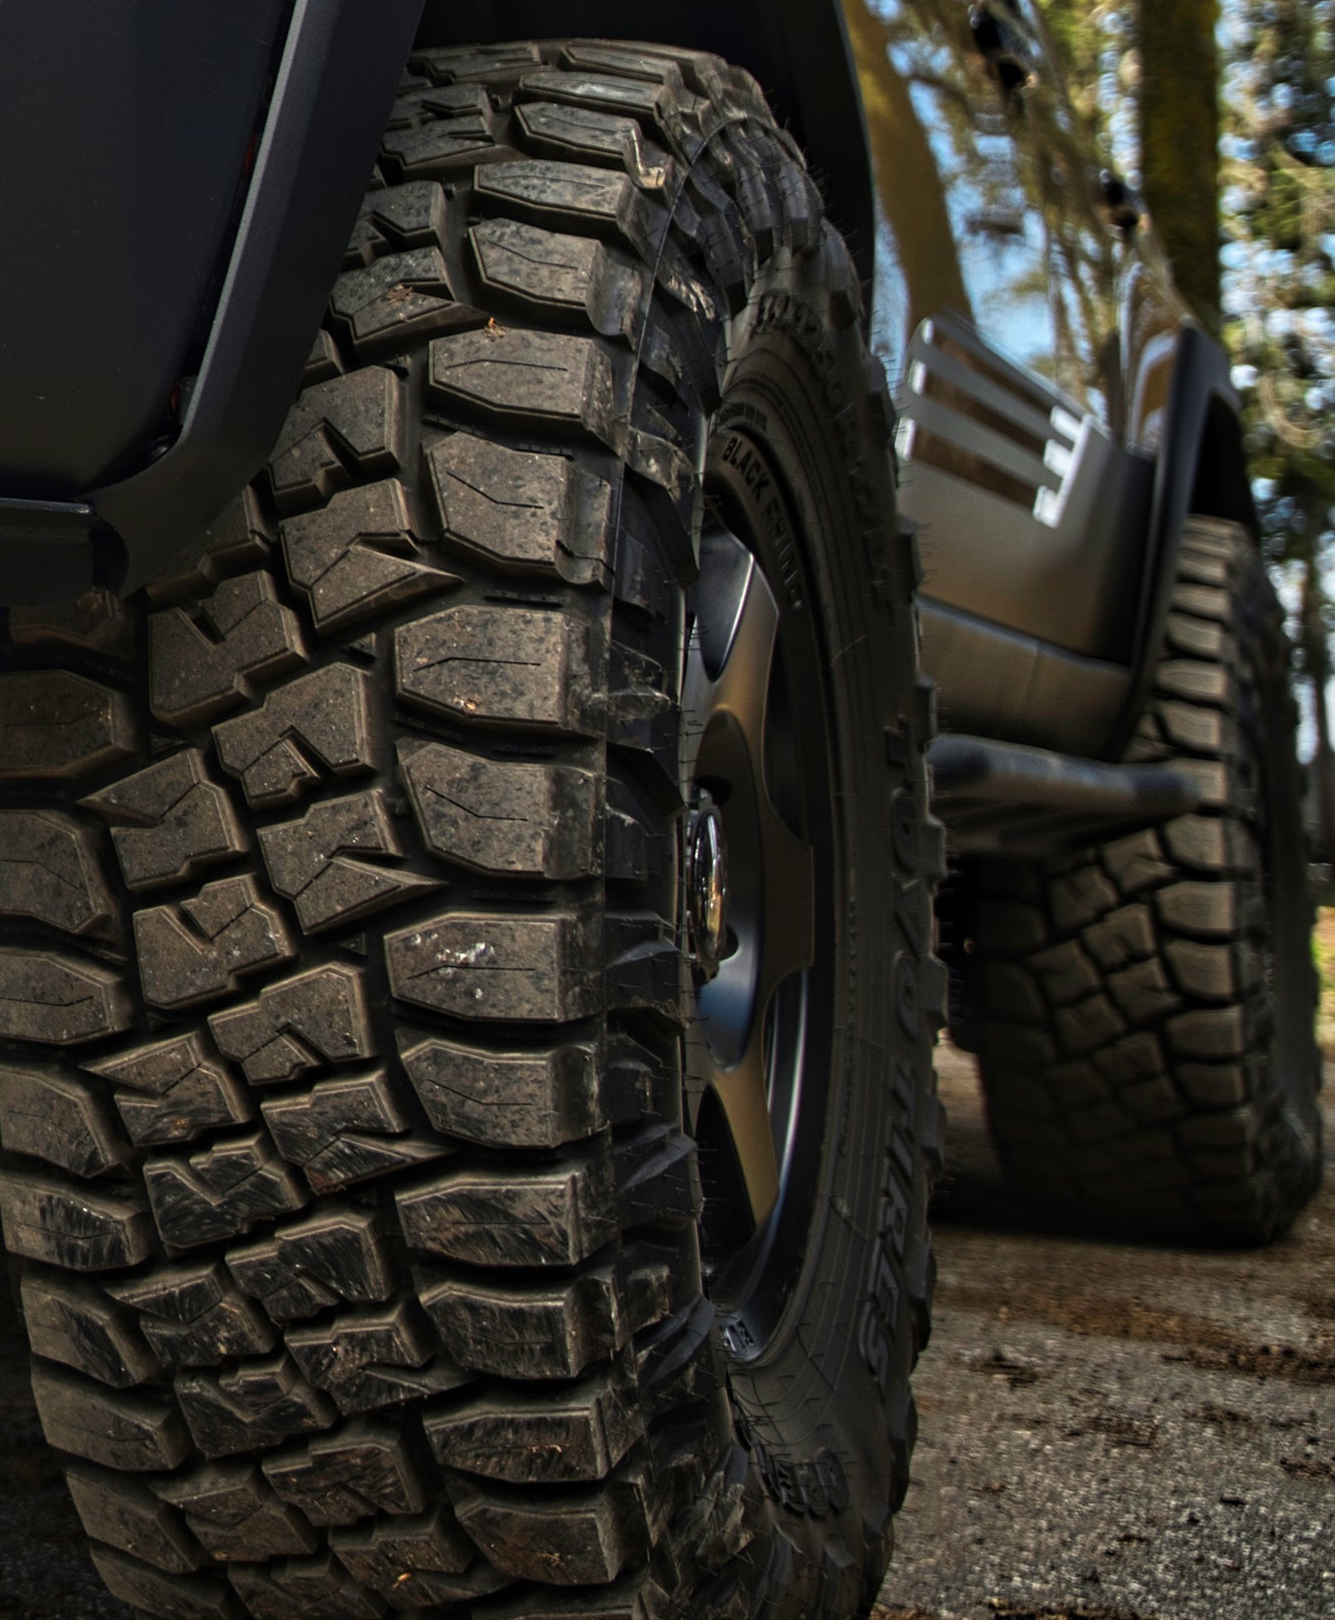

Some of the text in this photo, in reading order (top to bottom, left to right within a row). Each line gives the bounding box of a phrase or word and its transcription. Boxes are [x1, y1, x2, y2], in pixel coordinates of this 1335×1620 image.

[720, 436, 771, 501] BLACK
[856, 716, 922, 1404] TOYO TIRES
